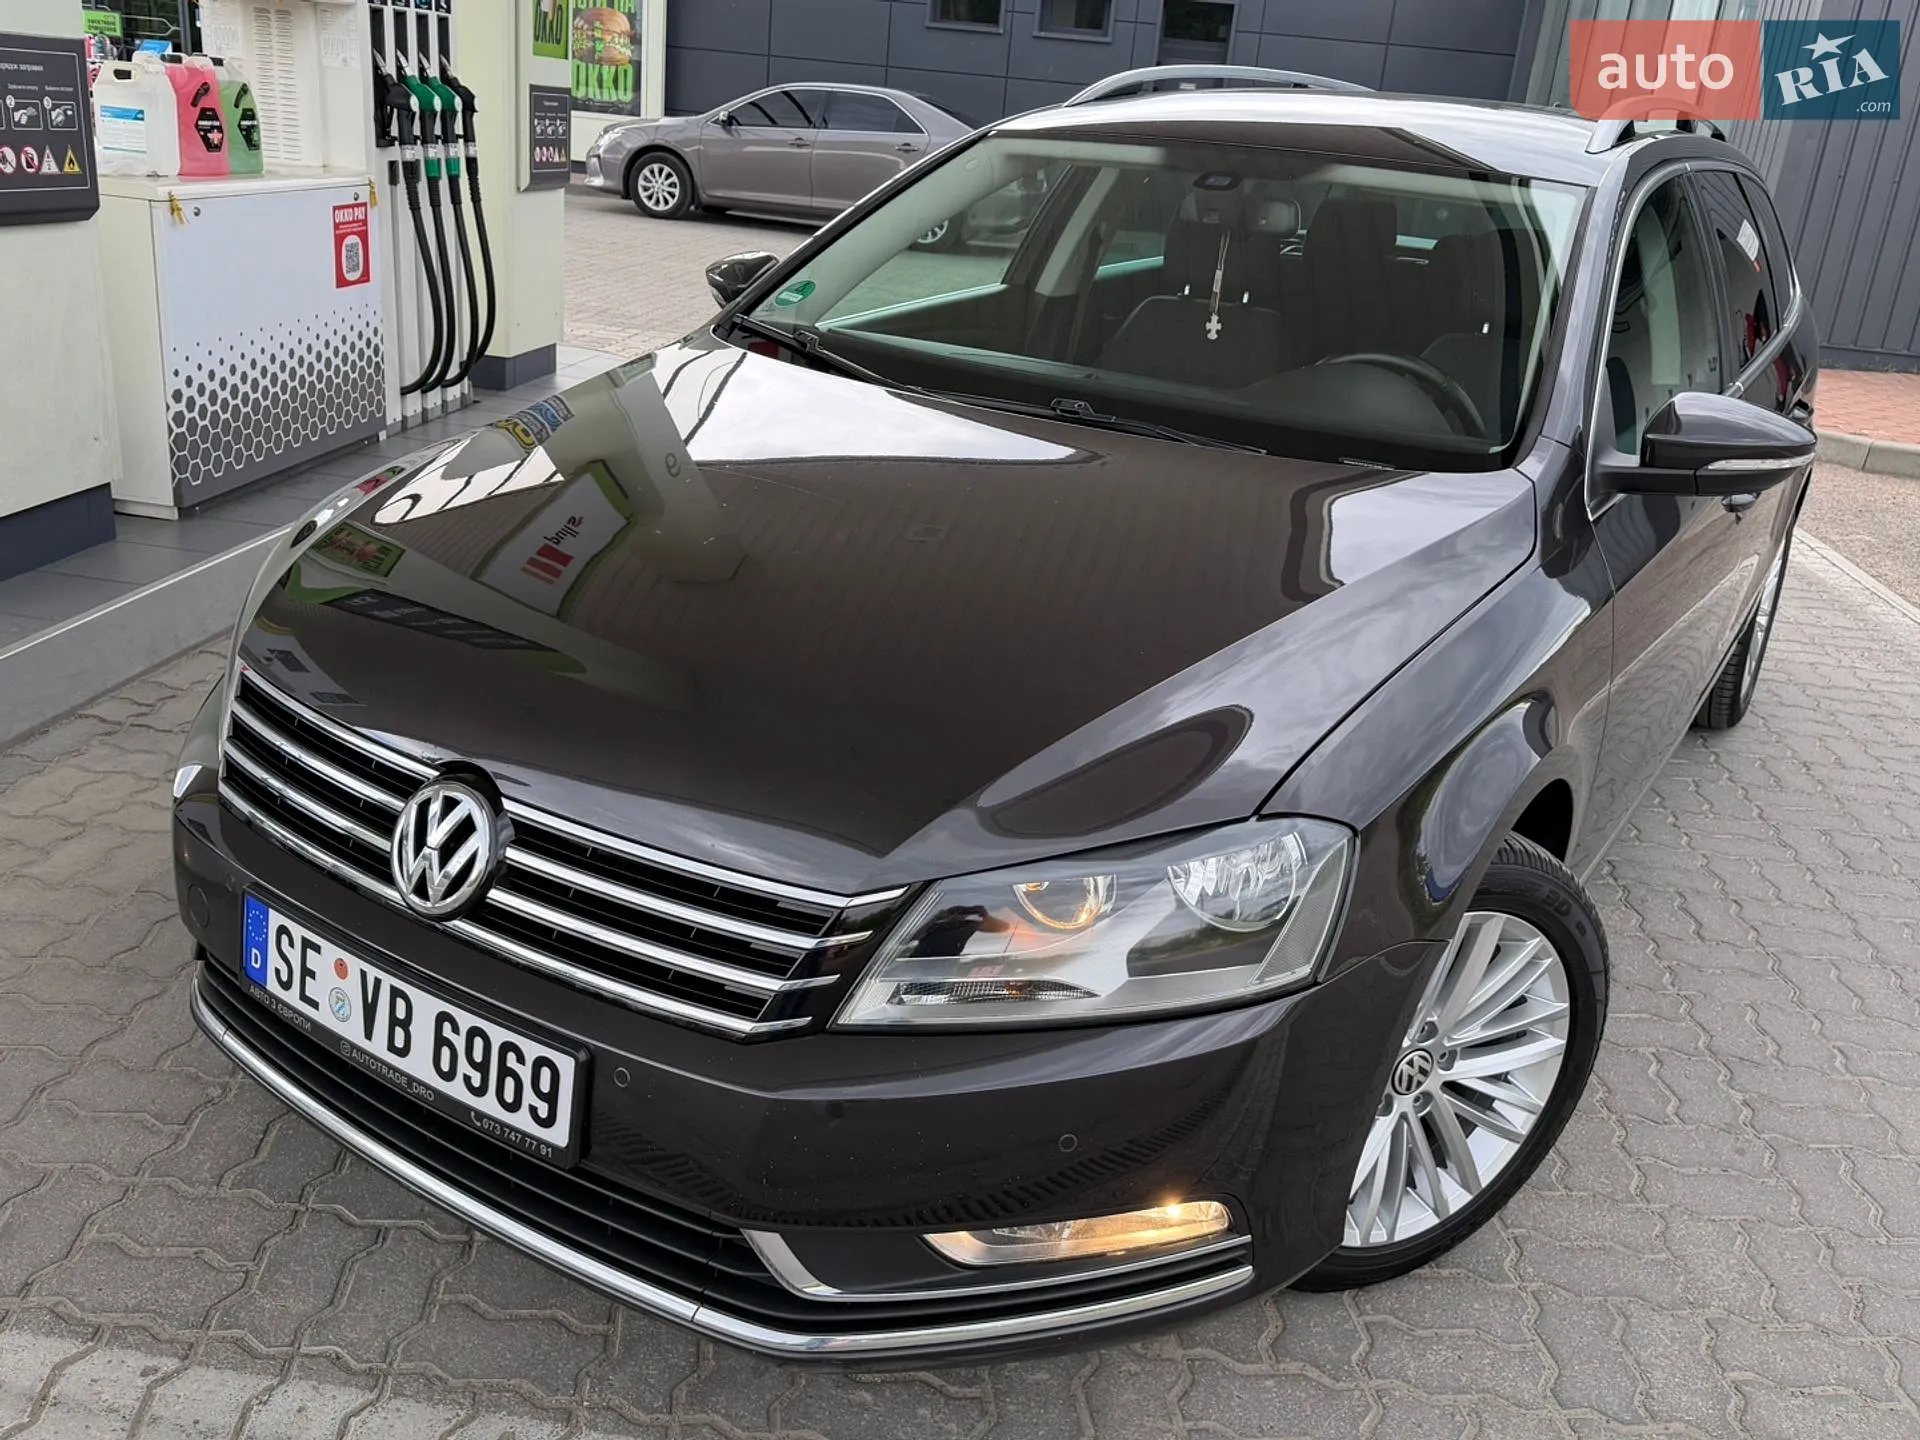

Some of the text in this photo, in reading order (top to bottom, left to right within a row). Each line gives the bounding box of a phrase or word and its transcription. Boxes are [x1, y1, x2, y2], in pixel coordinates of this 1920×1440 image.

[571, 59, 633, 102] OKKO
[335, 208, 353, 224] OKKO
[251, 948, 262, 970] D
[274, 924, 561, 1129] SE VB 6969
[482, 1118, 501, 1135] 073
[503, 1127, 522, 1144] 747
[525, 1137, 538, 1151] 77
